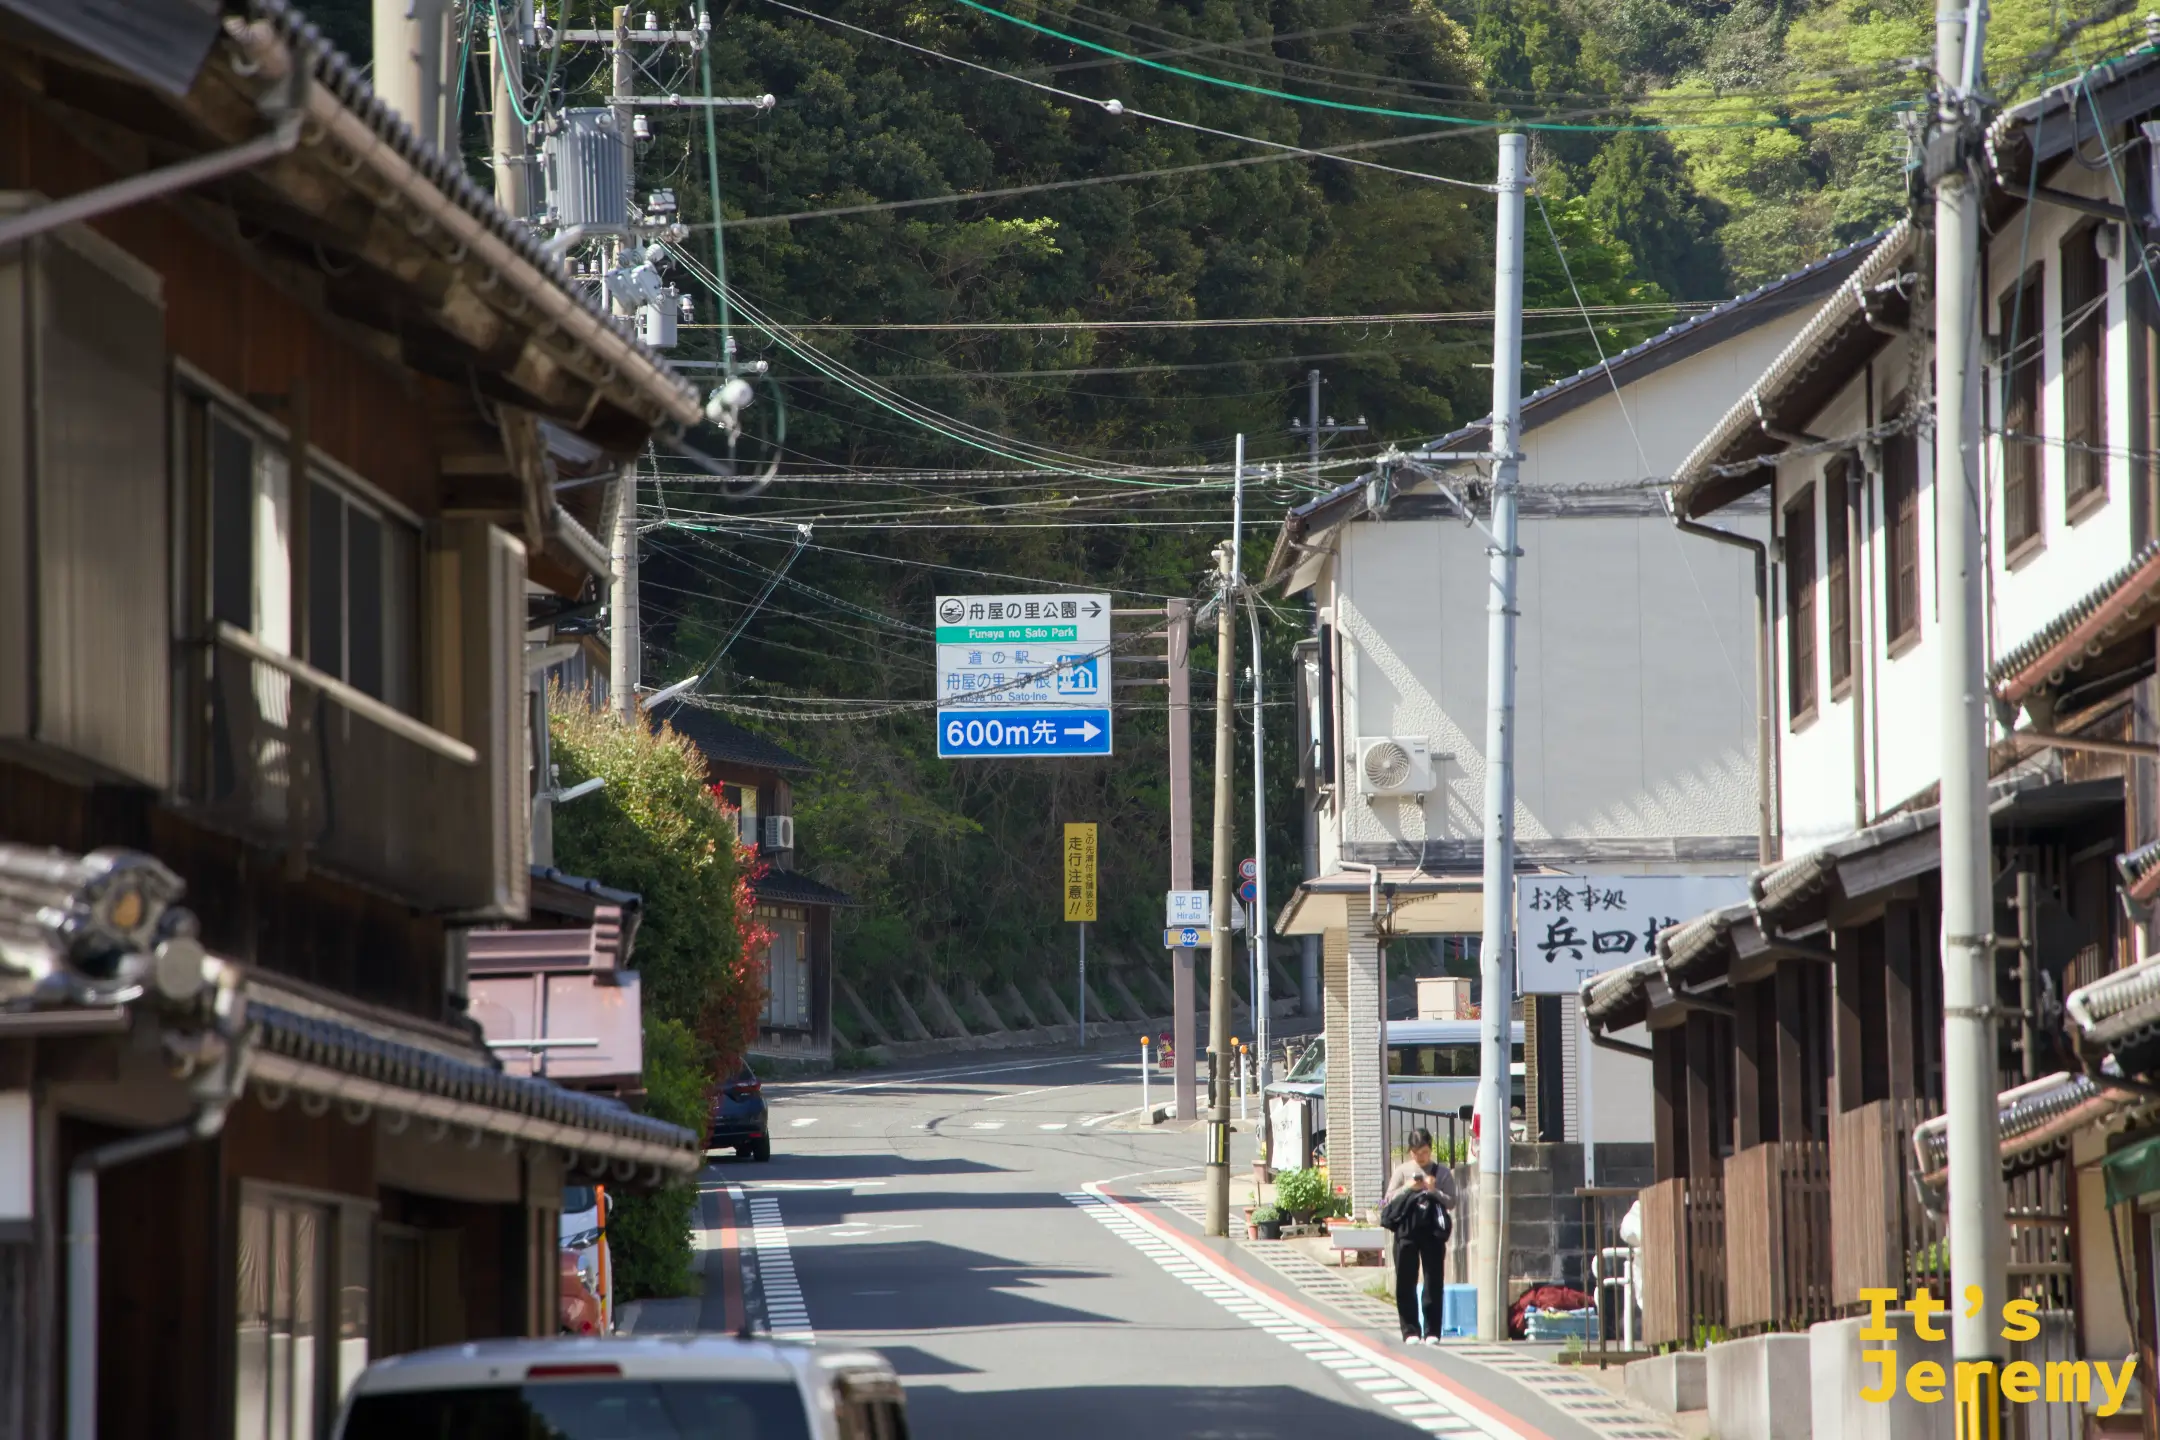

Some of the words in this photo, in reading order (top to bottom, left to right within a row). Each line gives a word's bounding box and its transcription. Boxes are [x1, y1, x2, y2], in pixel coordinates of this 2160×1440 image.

[969, 601, 1077, 620] 舟屋の里公園
[969, 629, 1004, 641] Funaya
[1009, 630, 1021, 638] no
[1025, 627, 1047, 638] Sato
[1052, 627, 1074, 638] Park
[968, 650, 1029, 665] 道の駅
[946, 719, 1056, 746] 600m先
[1244, 864, 1256, 873] 40
[1175, 896, 1202, 910] 平田
[1529, 884, 1627, 912] お食事処
[1177, 911, 1201, 920] Hirata
[1181, 932, 1197, 943] 622
[1576, 969, 1599, 985] TE
